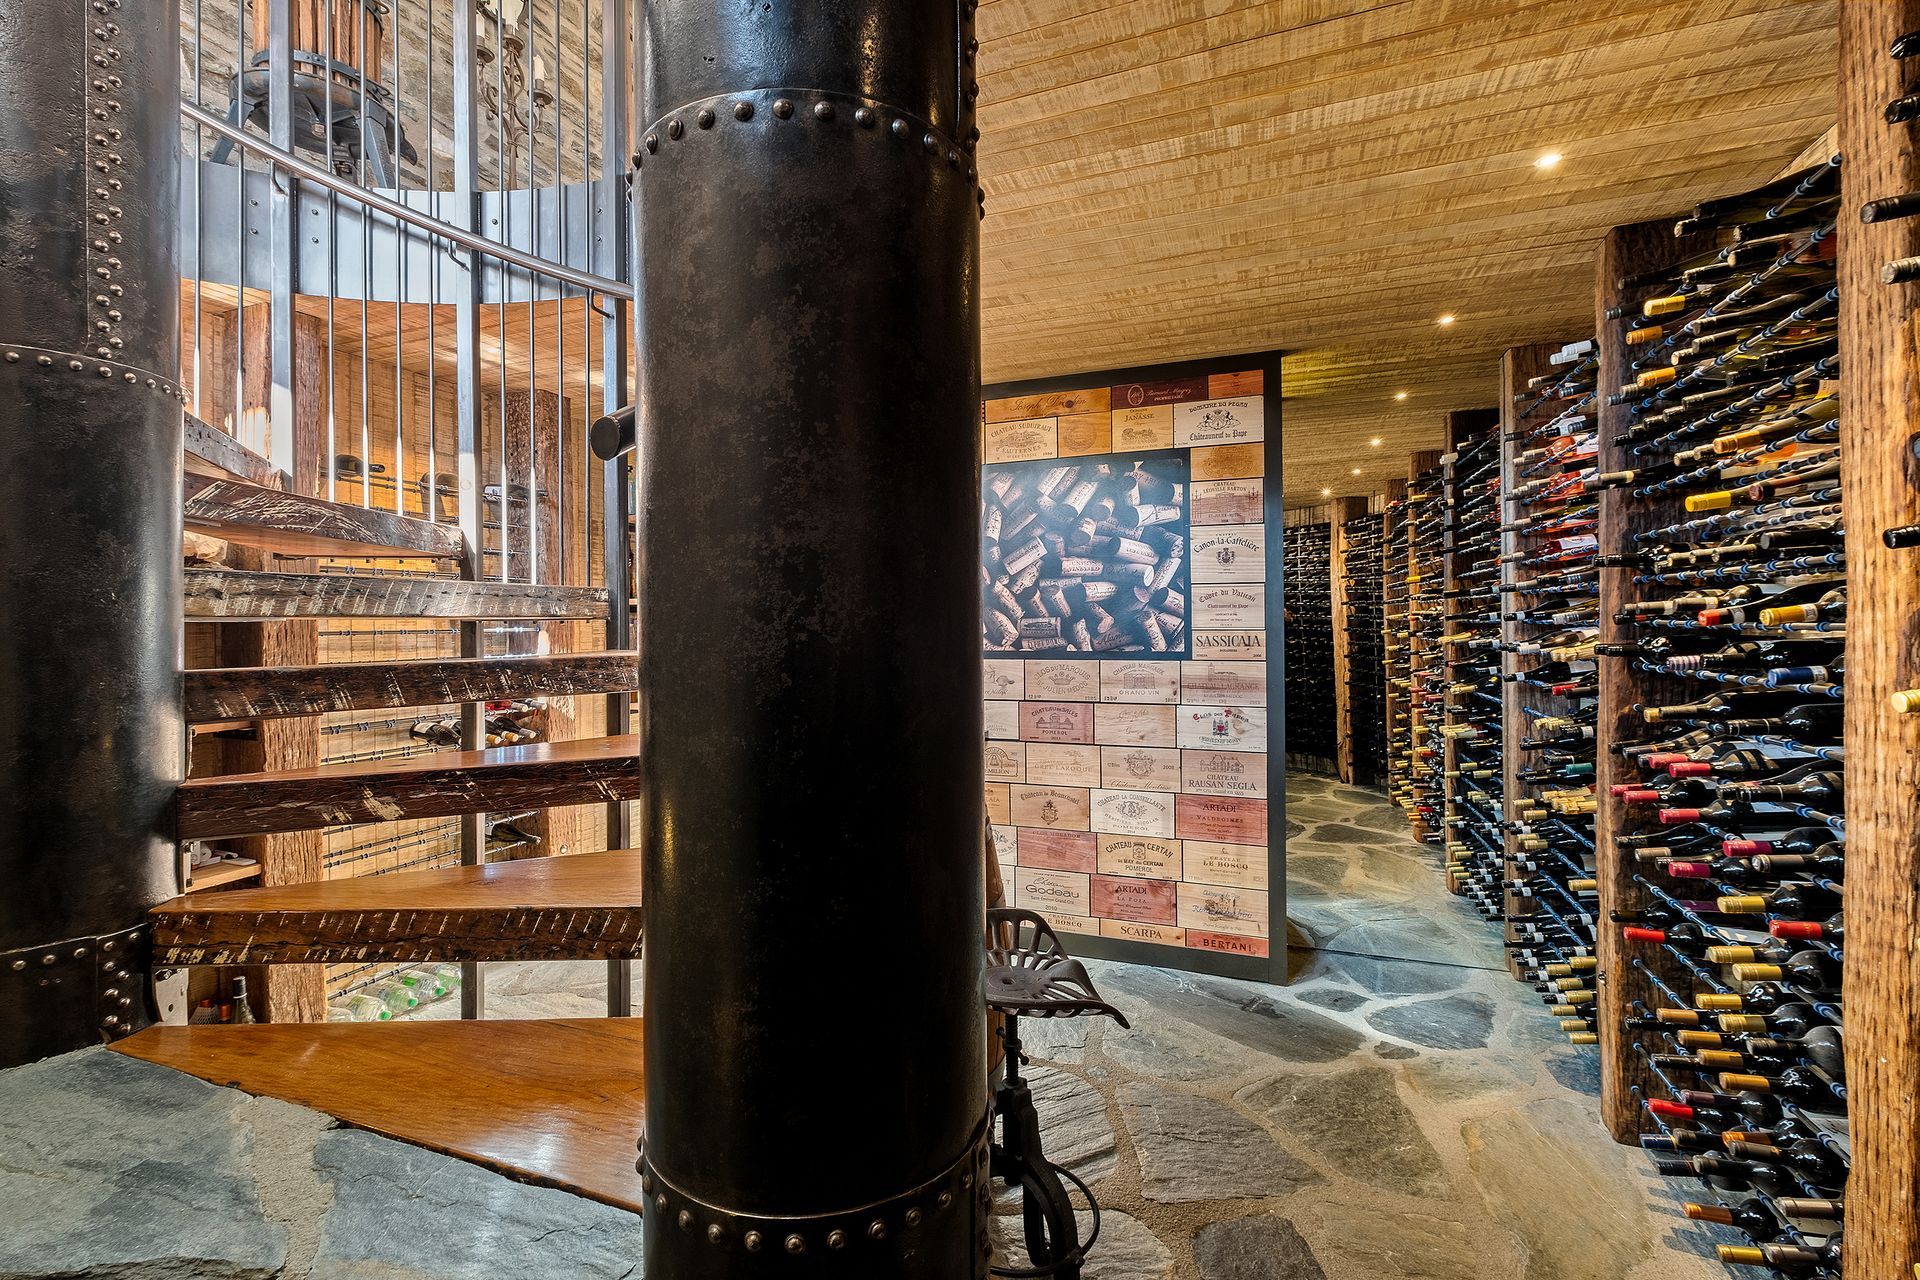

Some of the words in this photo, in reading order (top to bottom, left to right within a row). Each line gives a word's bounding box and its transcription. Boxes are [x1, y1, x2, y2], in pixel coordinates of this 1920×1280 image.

[1196, 635, 1262, 648] SASSICAIA
[1188, 780, 1225, 789] RAUSAN
[1202, 803, 1237, 814] ARTADI
[1105, 841, 1132, 854] CHATEAU
[1146, 842, 1174, 858] CERTAN
[1125, 865, 1154, 873] POMEROL
[1142, 860, 1164, 868] CERTAN
[1202, 860, 1215, 868] LE
[1217, 862, 1249, 871] BOSCQ
[1025, 884, 1080, 899] Godeau
[1115, 885, 1148, 895] ARTADI
[1055, 919, 1083, 929] BOSCQ
[1120, 925, 1163, 940] SCARPA
[1203, 938, 1252, 952] BERTANI
